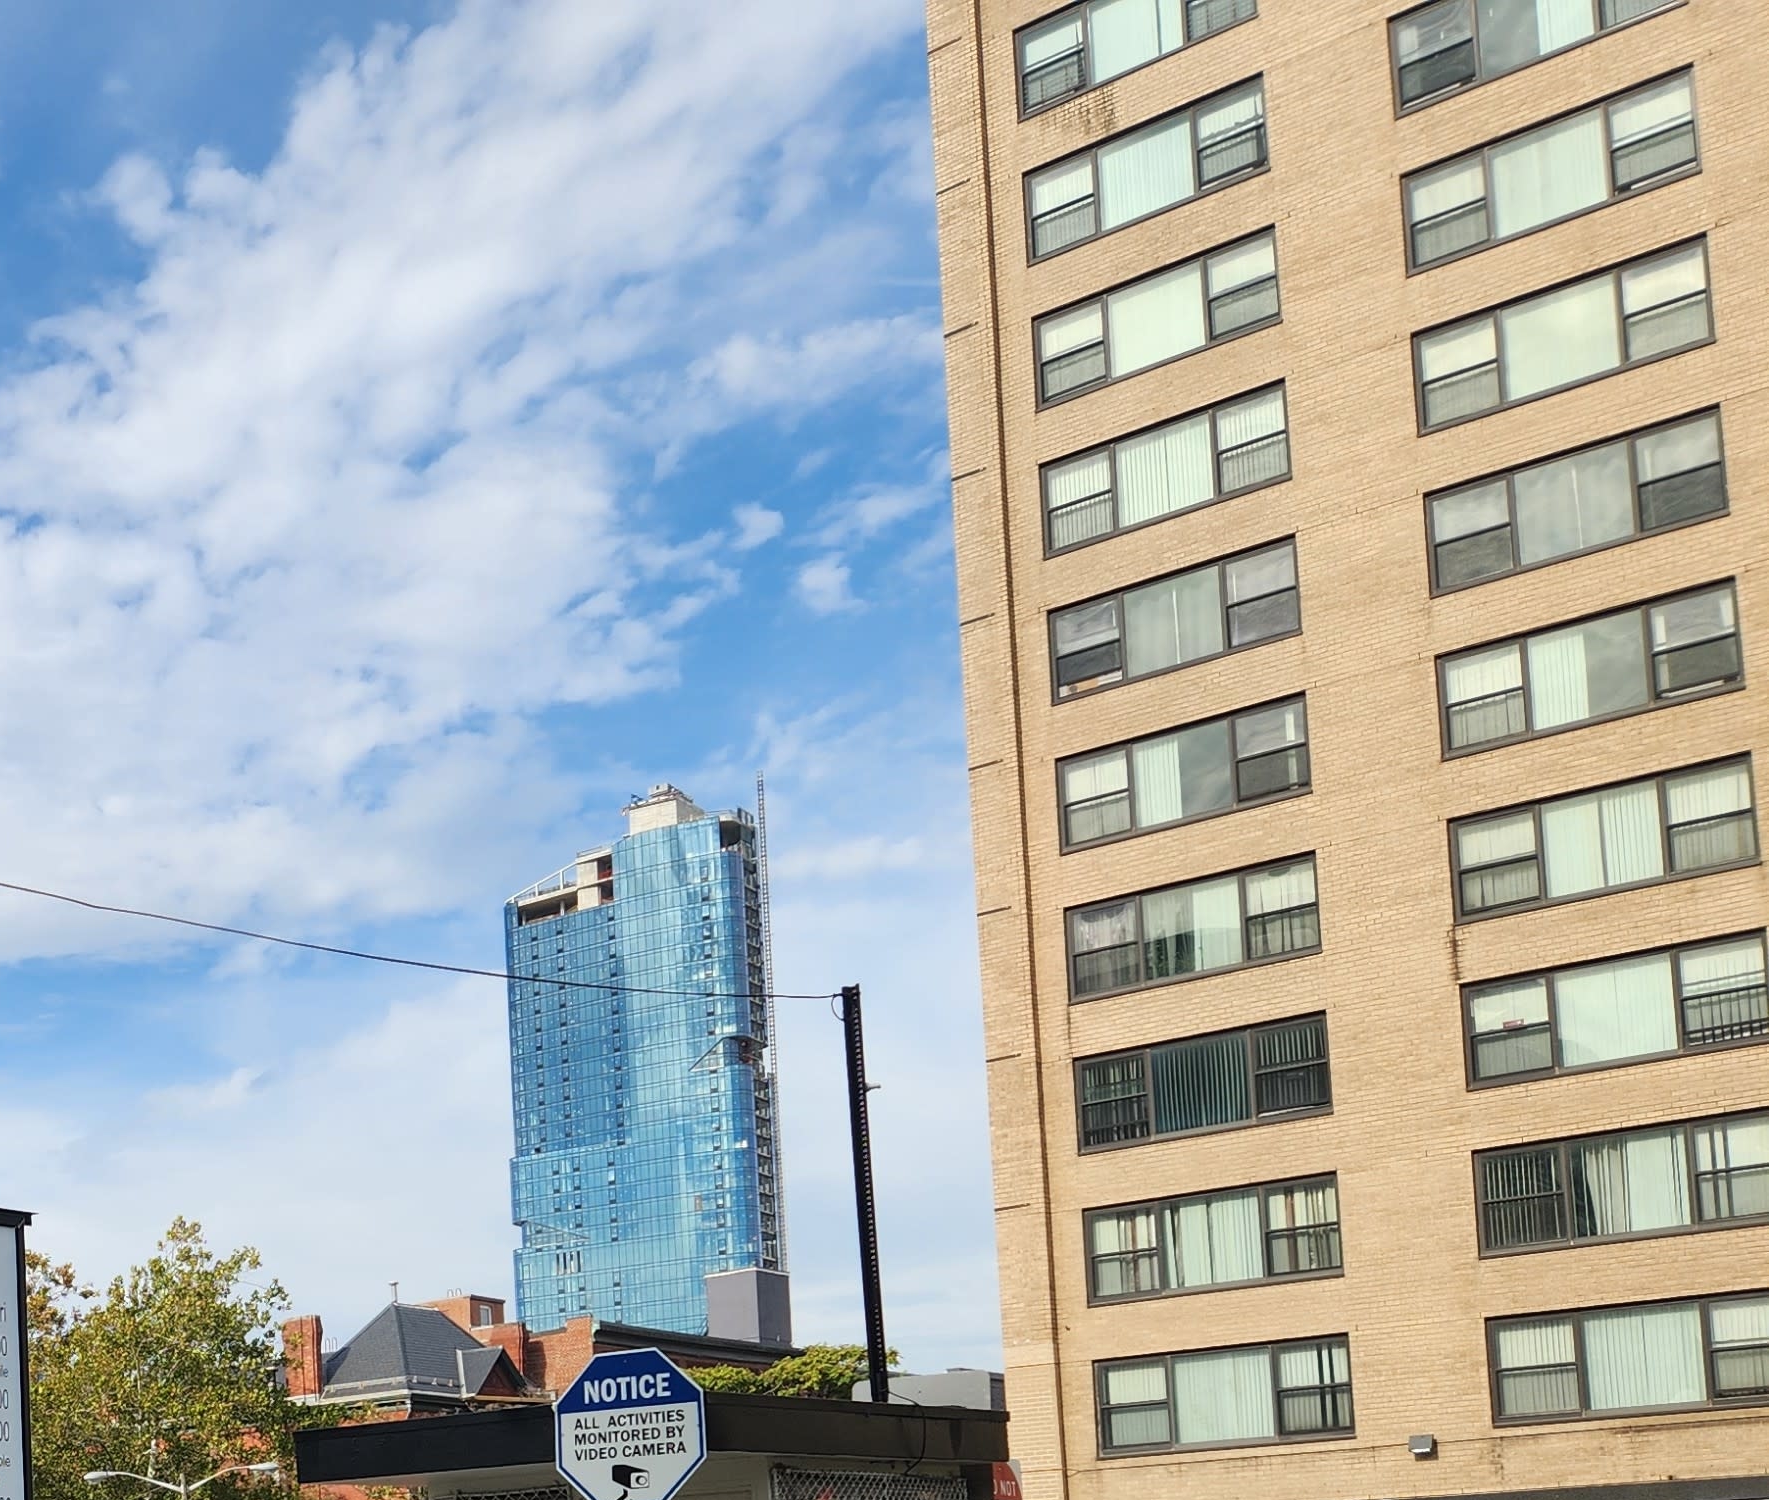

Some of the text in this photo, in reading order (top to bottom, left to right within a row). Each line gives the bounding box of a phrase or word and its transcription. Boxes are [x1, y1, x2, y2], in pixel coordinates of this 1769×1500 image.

[584, 1372, 671, 1404] NOTICE
[574, 1410, 685, 1430] ALL ACTIVITIES
[574, 1425, 685, 1446] MONITORED BY
[575, 1442, 687, 1461] VIDEO CAMERA
[1000, 1481, 1015, 1496] NOT
